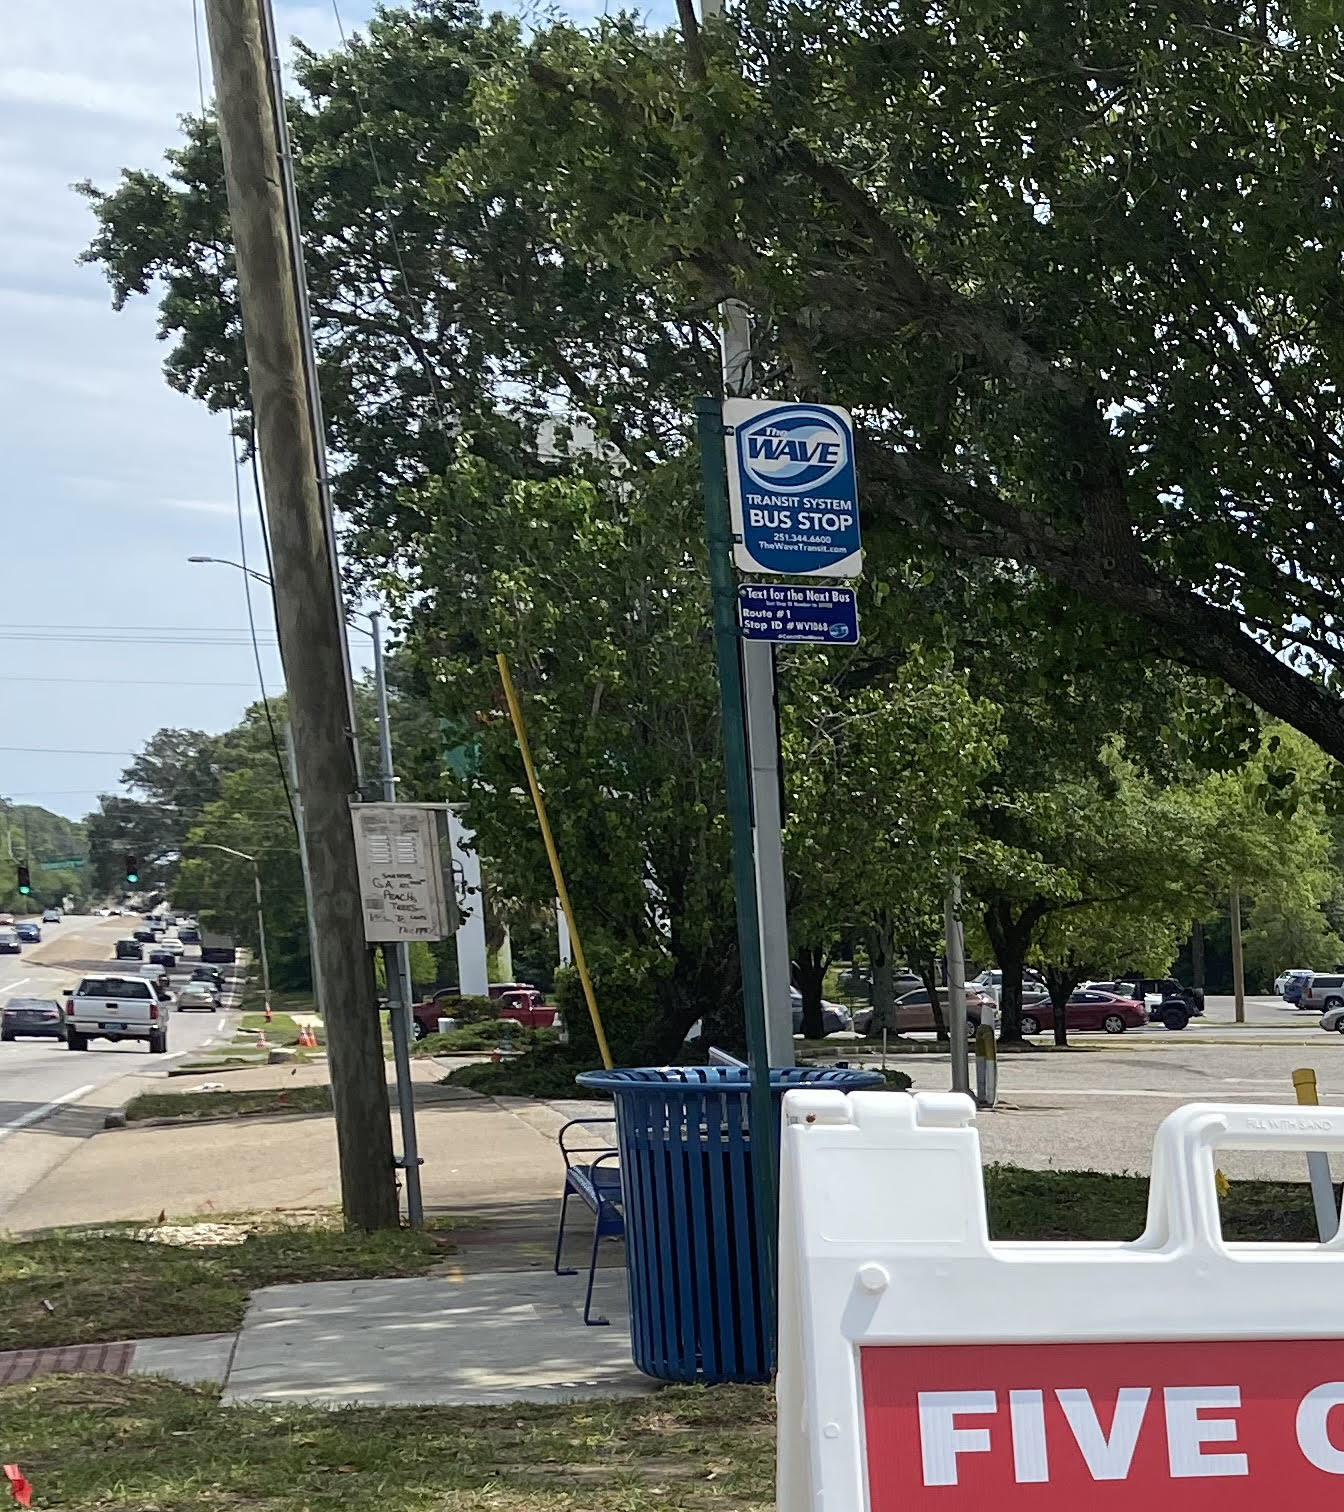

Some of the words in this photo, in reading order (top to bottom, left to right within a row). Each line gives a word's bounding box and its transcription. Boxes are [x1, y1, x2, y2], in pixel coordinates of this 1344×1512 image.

[766, 427, 787, 437] The
[748, 438, 840, 464] WAVE
[746, 494, 799, 507] TRANSIT
[803, 498, 852, 510] SYSTEM
[750, 509, 792, 528] BUS
[798, 512, 853, 531] STOP
[773, 532, 831, 544] 251.344.6600
[758, 541, 847, 553] TheWaveTransit.com
[747, 588, 767, 599] Text
[770, 588, 785, 600] for
[787, 589, 804, 601] the
[806, 590, 830, 602] Next
[832, 591, 851, 603] Bus
[743, 609, 773, 618] Route
[787, 609, 791, 619] 1
[744, 620, 768, 631] Stop
[771, 620, 783, 629] ID
[917, 1385, 1250, 1487] FIVE
